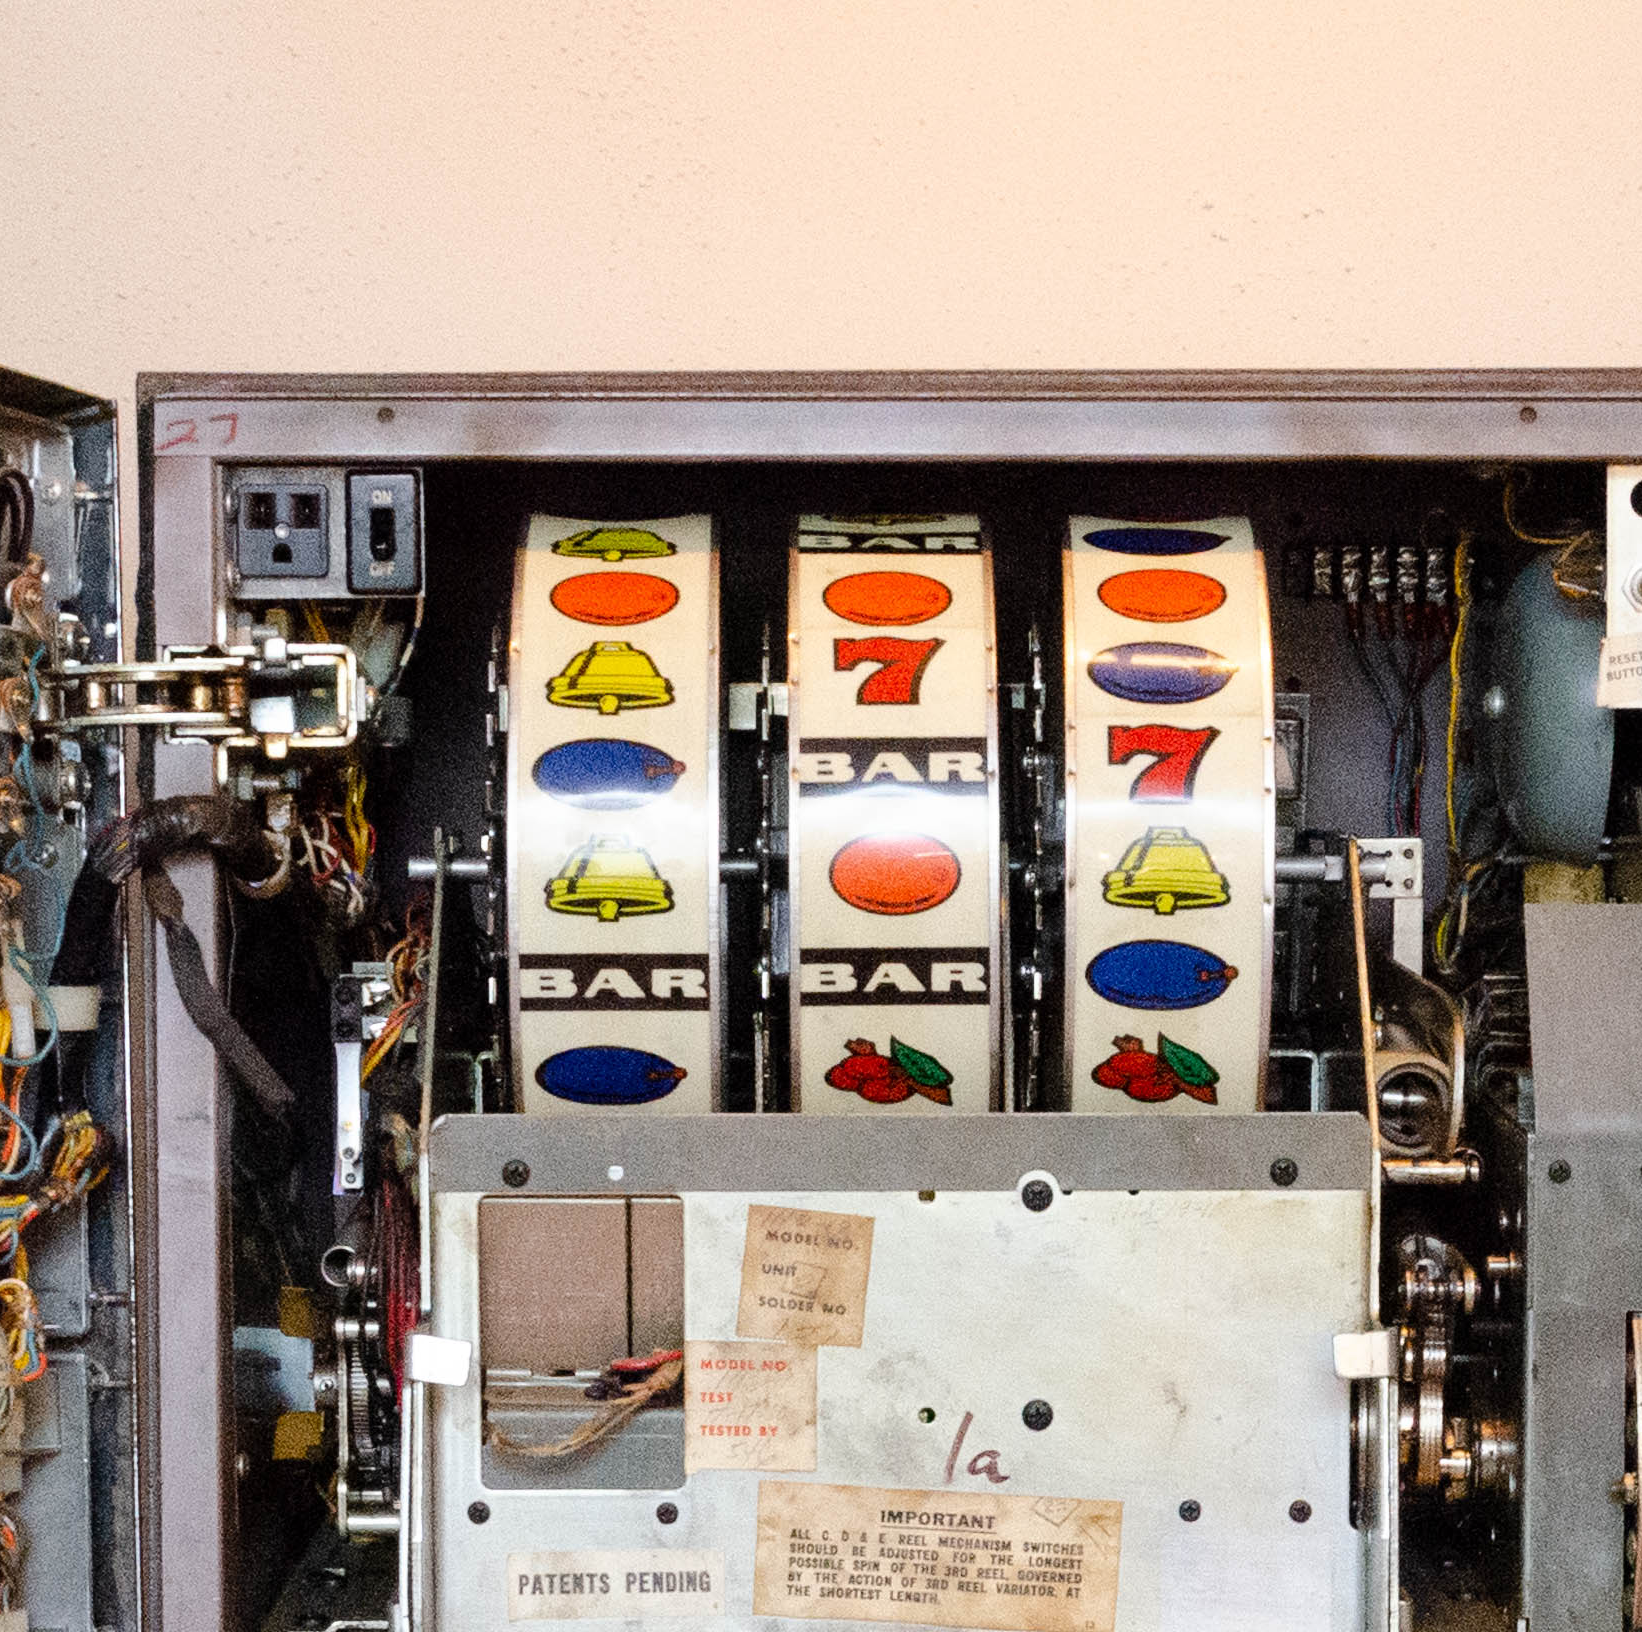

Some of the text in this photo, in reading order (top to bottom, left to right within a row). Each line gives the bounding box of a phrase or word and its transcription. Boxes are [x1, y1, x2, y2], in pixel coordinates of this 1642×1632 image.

[372, 489, 393, 505] ON
[798, 533, 980, 550] BAR
[833, 636, 947, 705] 7
[798, 751, 987, 784] BAR
[1107, 724, 1222, 804] 7
[519, 966, 709, 1001] BAR
[800, 961, 987, 995] BAR
[764, 1229, 820, 1246] MODEL
[761, 1263, 798, 1278] UNIT
[758, 1296, 815, 1313] SOLDER
[700, 1359, 757, 1372] MODEL
[700, 1391, 734, 1403] TEST
[700, 1425, 779, 1437] TESTED BY
[880, 1509, 997, 1530] IMPORTANT
[789, 1528, 811, 1541] ALL
[898, 1533, 928, 1547] REEL
[938, 1536, 1013, 1552] MECHANISM
[1022, 1541, 1085, 1557] SWITCHES
[789, 1543, 1083, 1570] SHOULD BE ADJUSTED FOR THE LONGEST
[788, 1556, 844, 1571] POSSIBLE
[852, 1560, 881, 1573] SPIN
[890, 1562, 907, 1574] OF
[913, 1563, 937, 1576] THE
[1017, 1569, 1083, 1585] GOVERNED
[518, 1571, 712, 1596] PATENTS PENDING
[786, 1584, 811, 1597] THE
[818, 1586, 882, 1601] SHORTEST
[787, 1571, 802, 1583] BY
[814, 1572, 838, 1585] THE
[847, 1574, 893, 1588] ACTION
[900, 1576, 917, 1589] OF
[1065, 1587, 1082, 1599] AT
